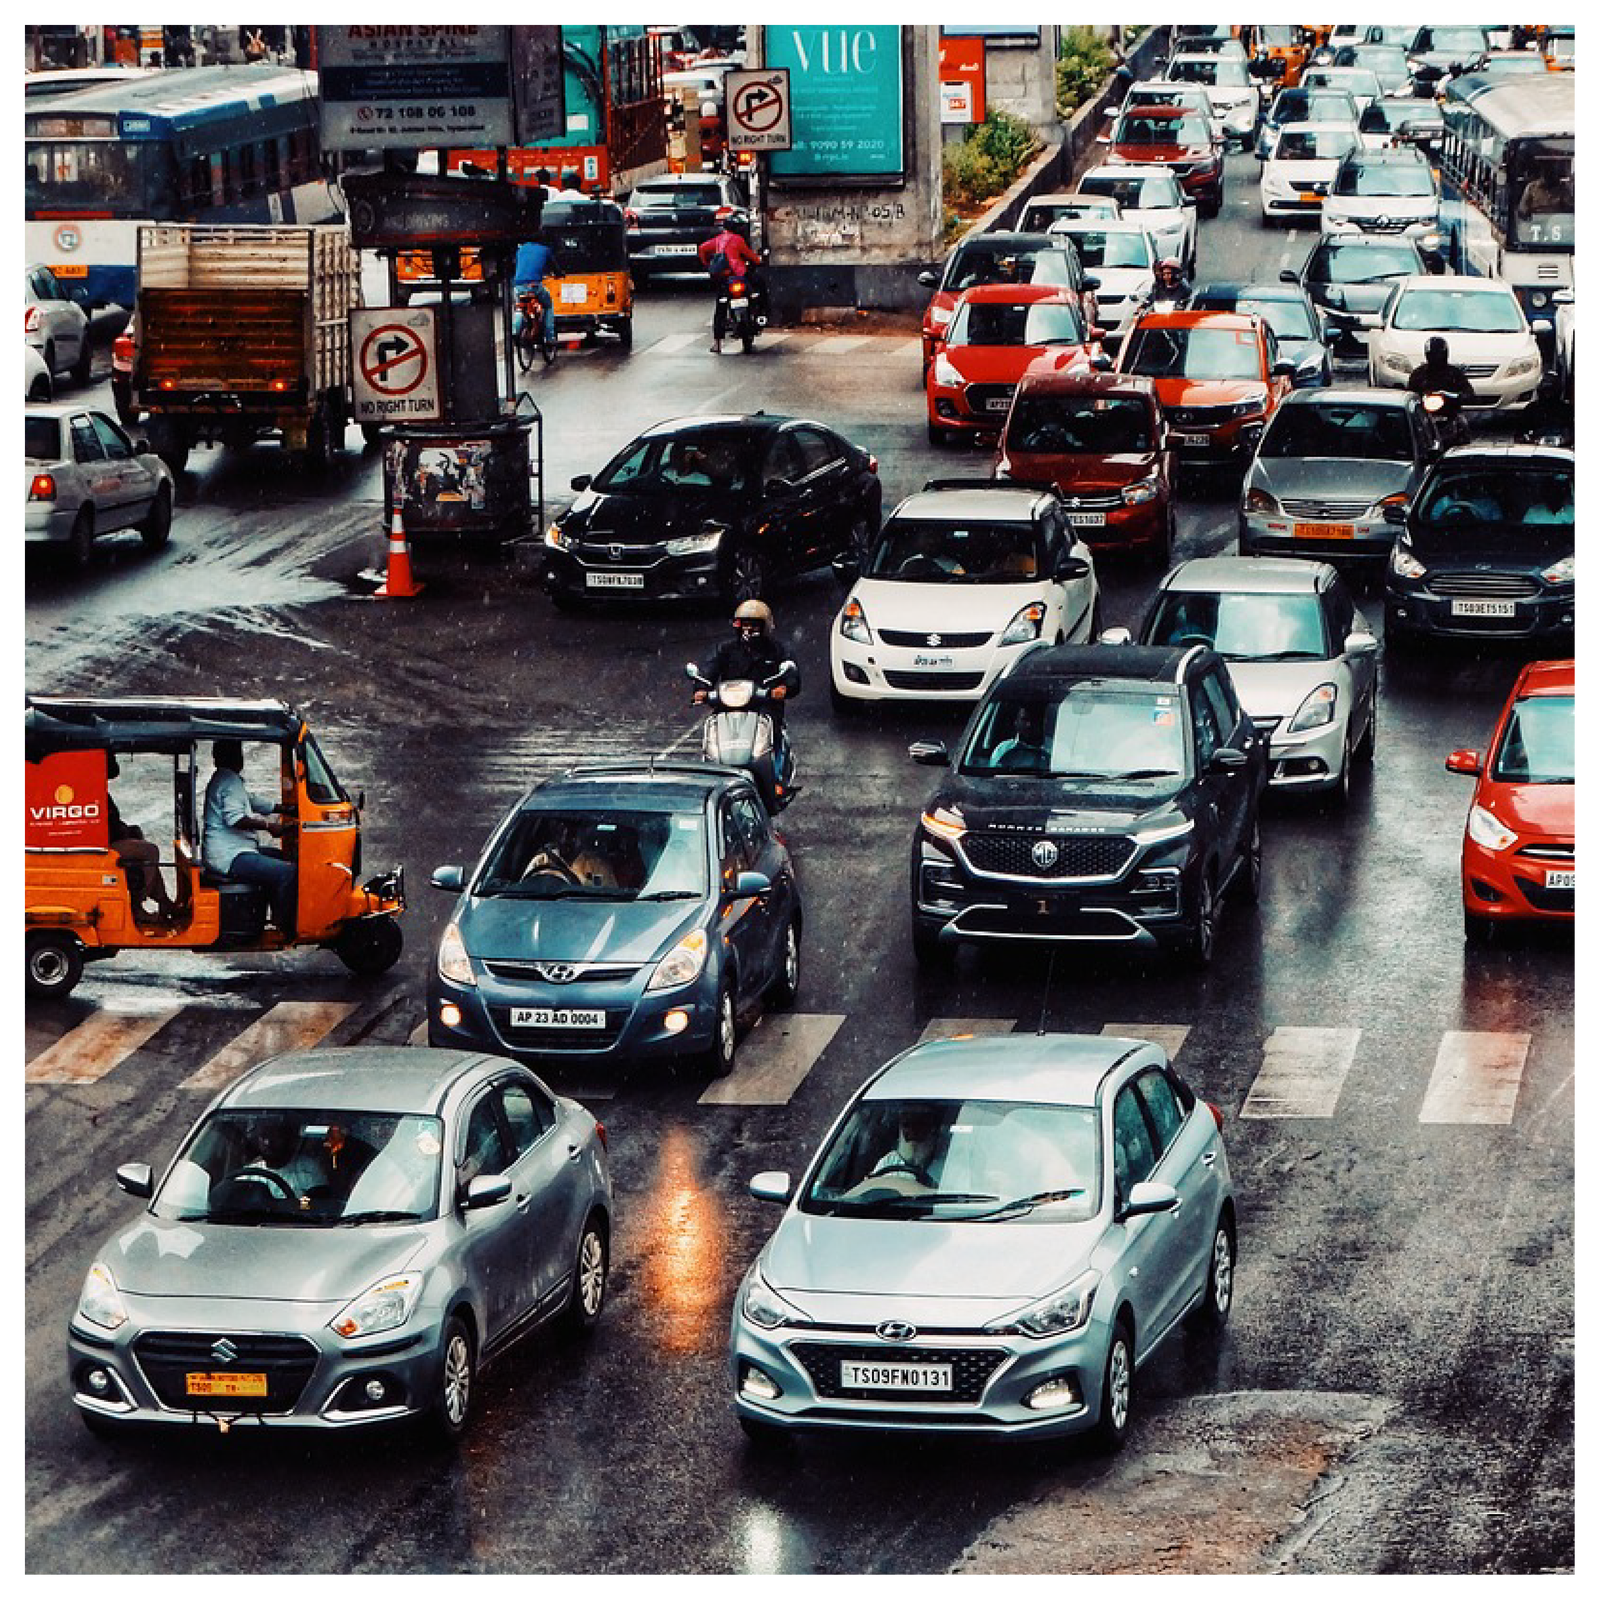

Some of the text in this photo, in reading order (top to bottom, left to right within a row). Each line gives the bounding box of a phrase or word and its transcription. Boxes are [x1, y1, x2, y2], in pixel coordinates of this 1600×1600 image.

[348, 22, 478, 38] ASIAN SPINE
[792, 30, 876, 74] vue
[375, 107, 393, 118] 72
[360, 398, 435, 413] NO RIGHT TURN
[30, 805, 99, 819] VIRGO
[517, 1011, 598, 1025] AP 23 AD 0004
